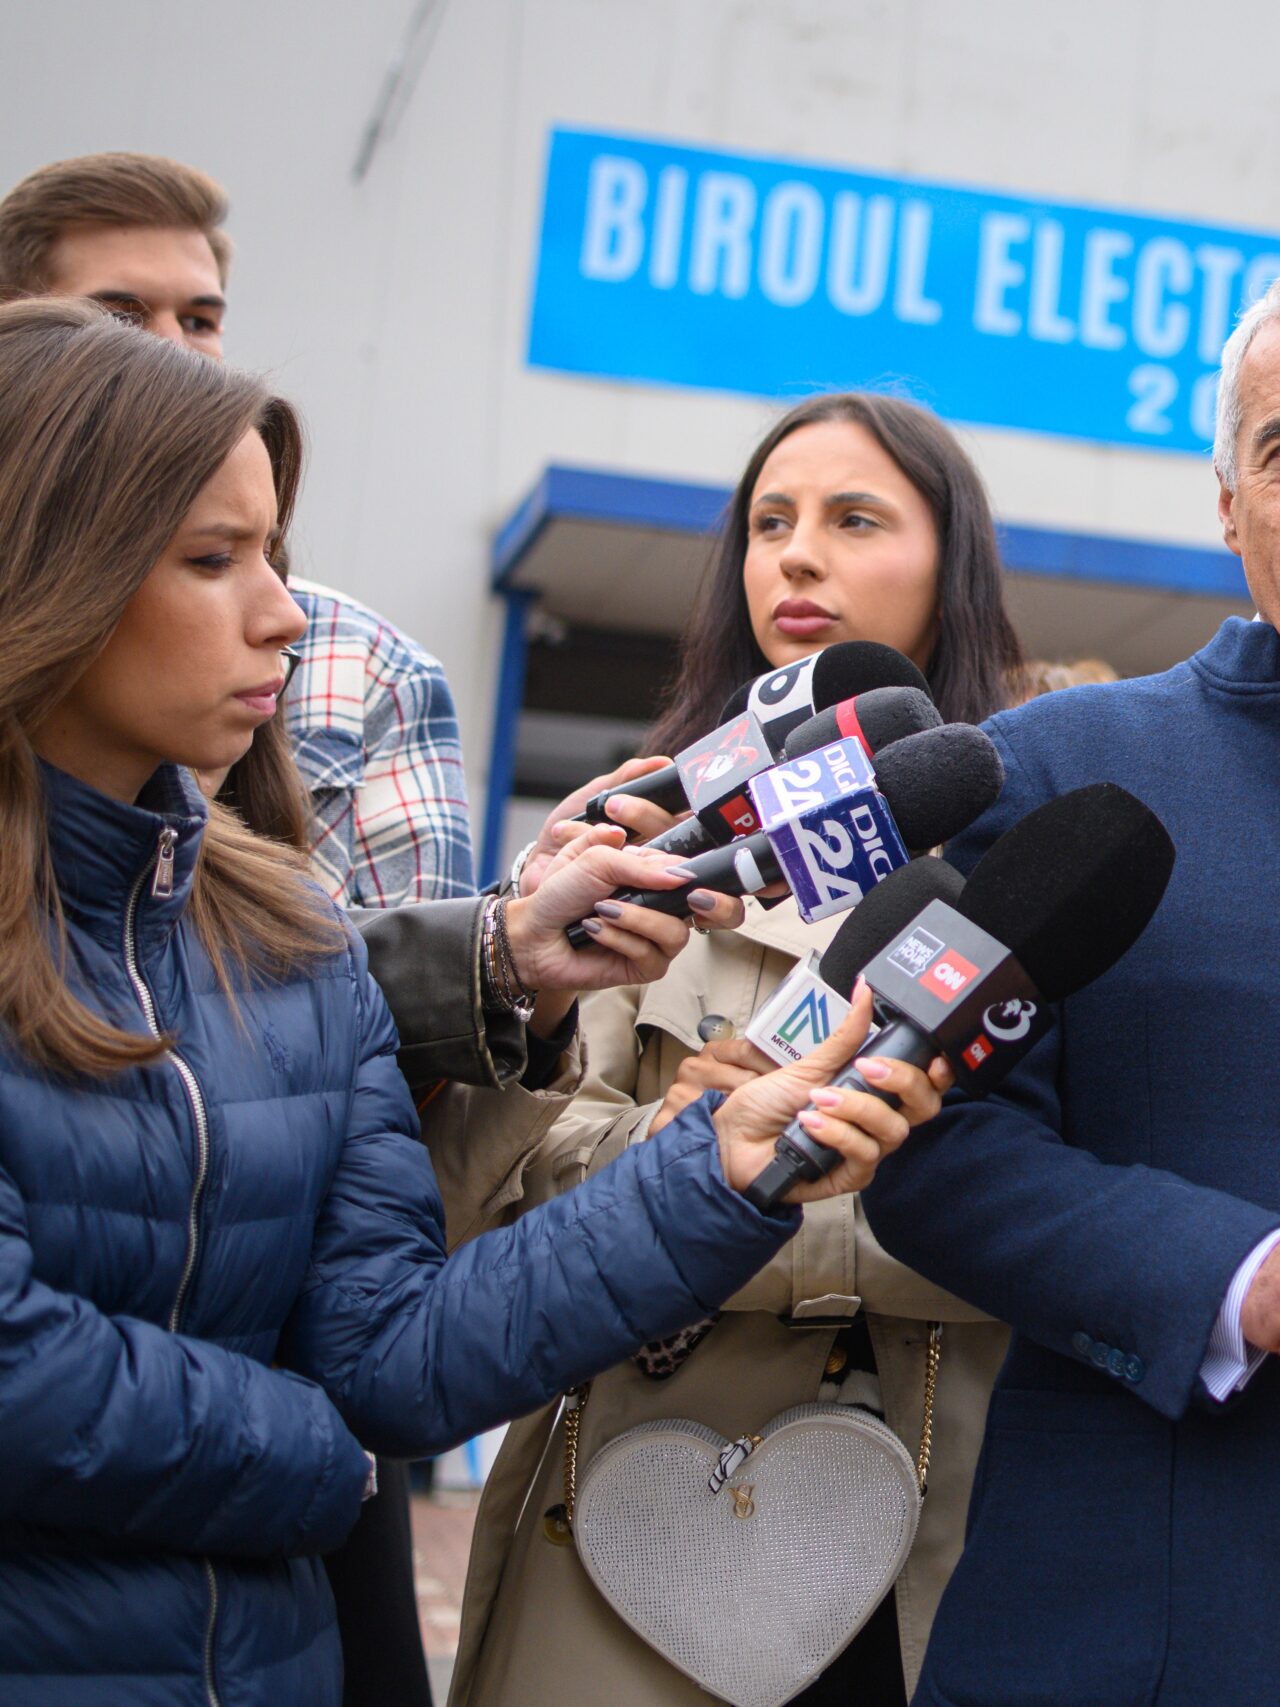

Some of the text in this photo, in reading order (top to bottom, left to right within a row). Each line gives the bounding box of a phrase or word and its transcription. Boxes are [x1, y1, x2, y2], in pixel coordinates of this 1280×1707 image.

[579, 152, 942, 325] BIROUL
[824, 745, 860, 793] DIGI
[850, 804, 894, 883] DIG
[789, 817, 864, 915] 24
[898, 942, 926, 967] HOUR
[908, 936, 934, 958] NEWS
[933, 962, 967, 991] CNN
[771, 1034, 802, 1061] METRO
